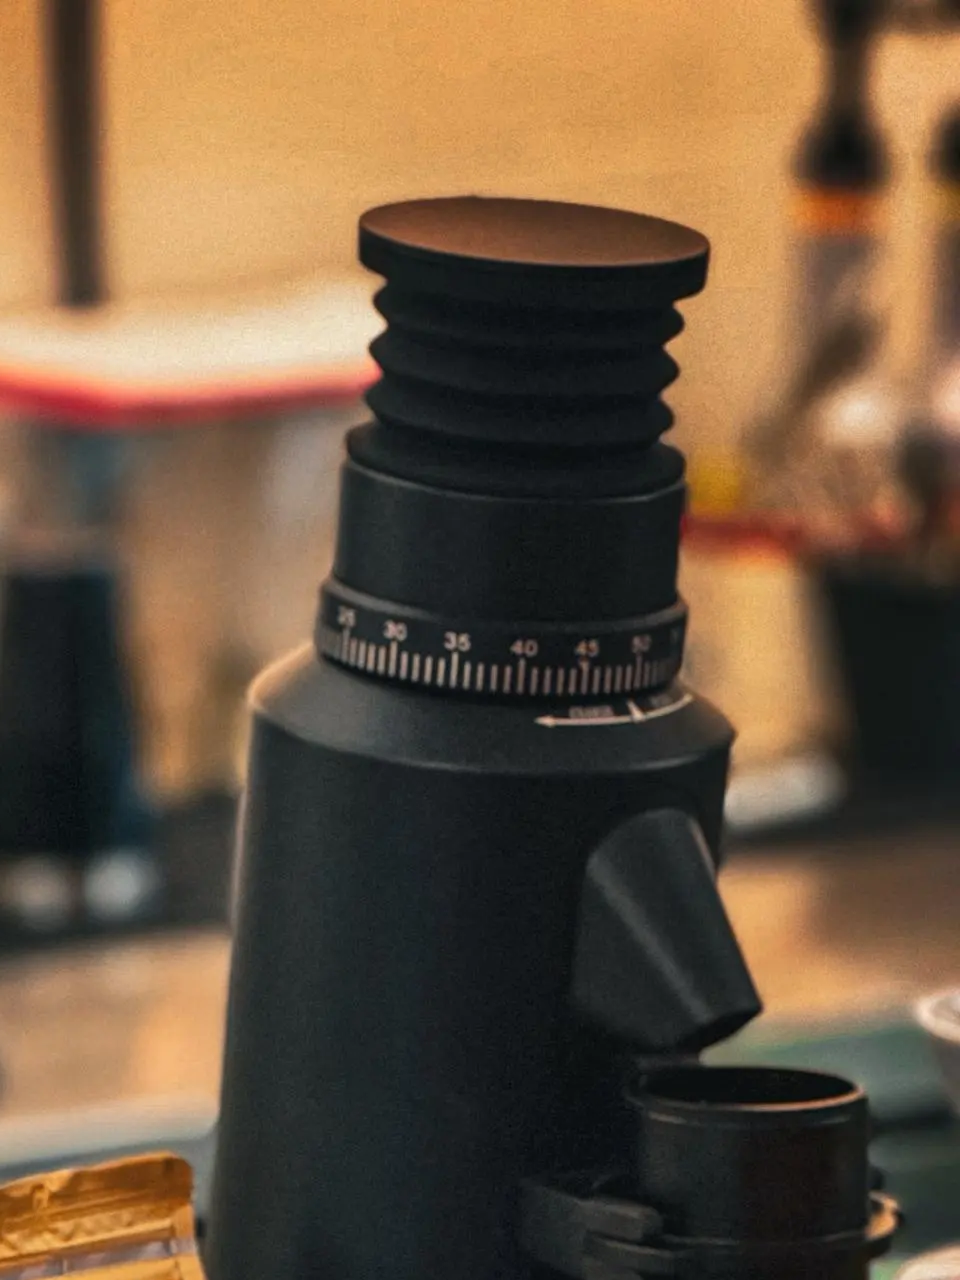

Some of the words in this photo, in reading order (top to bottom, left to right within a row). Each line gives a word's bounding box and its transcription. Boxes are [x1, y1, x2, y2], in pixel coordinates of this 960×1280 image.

[383, 619, 407, 641] 30
[444, 631, 471, 652] 35
[510, 639, 538, 657] 40
[575, 639, 599, 657] 45
